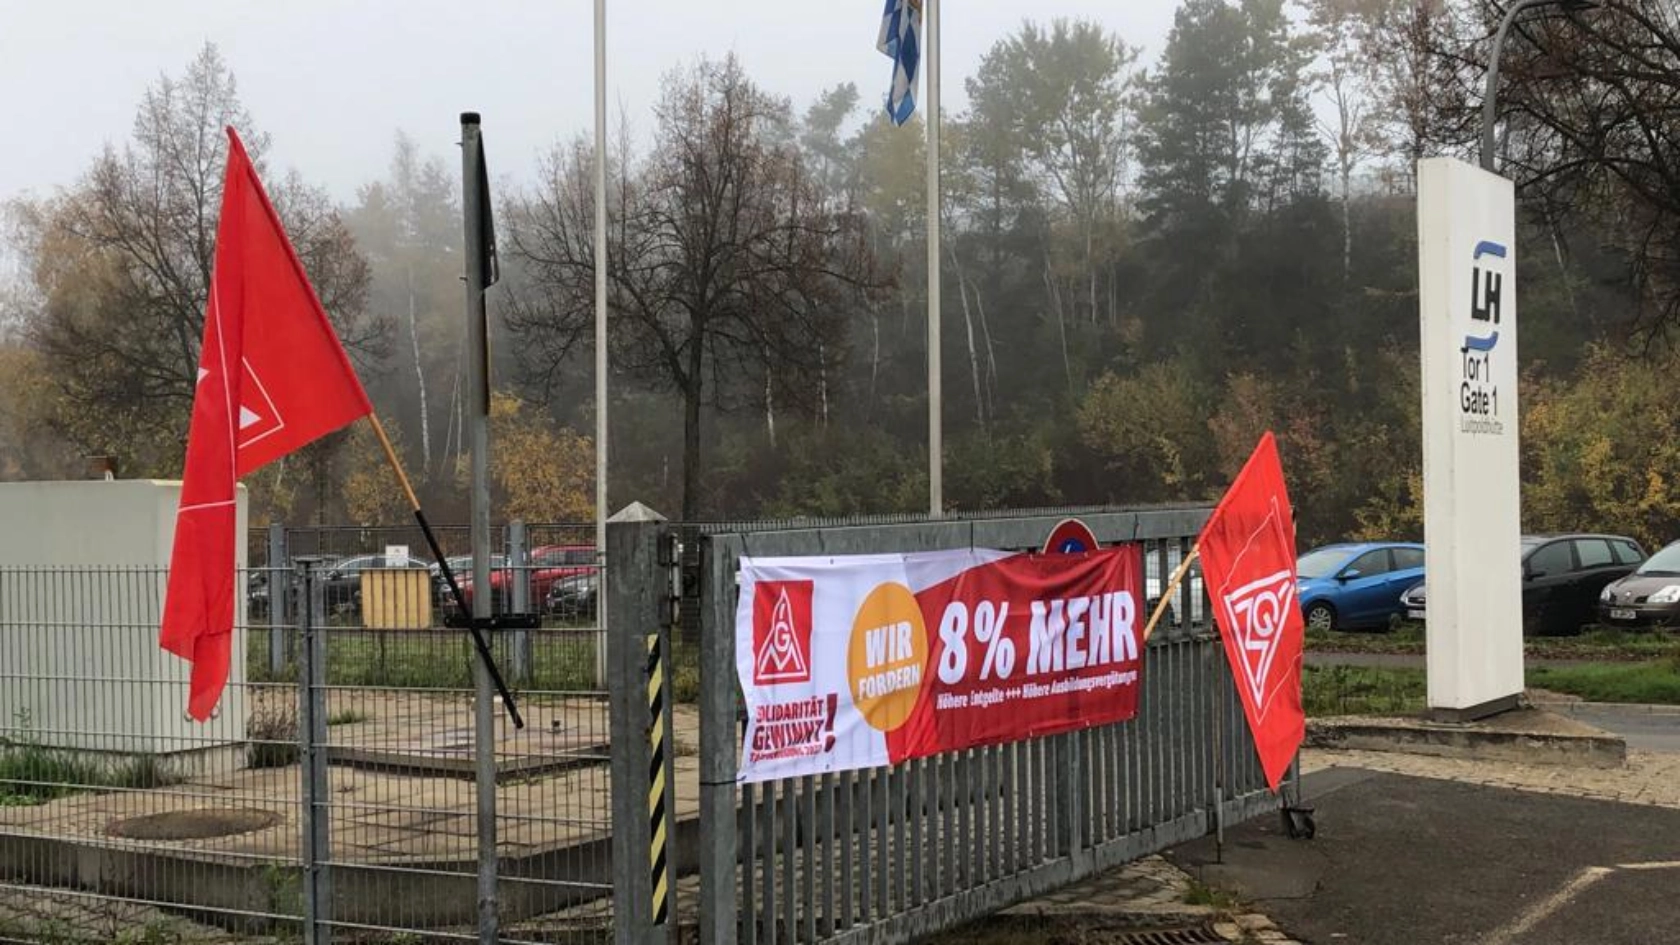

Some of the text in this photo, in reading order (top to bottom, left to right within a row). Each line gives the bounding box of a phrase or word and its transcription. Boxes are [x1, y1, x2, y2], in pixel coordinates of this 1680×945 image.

[1471, 266, 1502, 325] LH
[1460, 346, 1490, 383] Tor 1
[1460, 381, 1498, 416] Gate 1
[865, 620, 914, 669] WIR
[938, 590, 1139, 684] 8% MEHR
[859, 661, 921, 701] FORDERN
